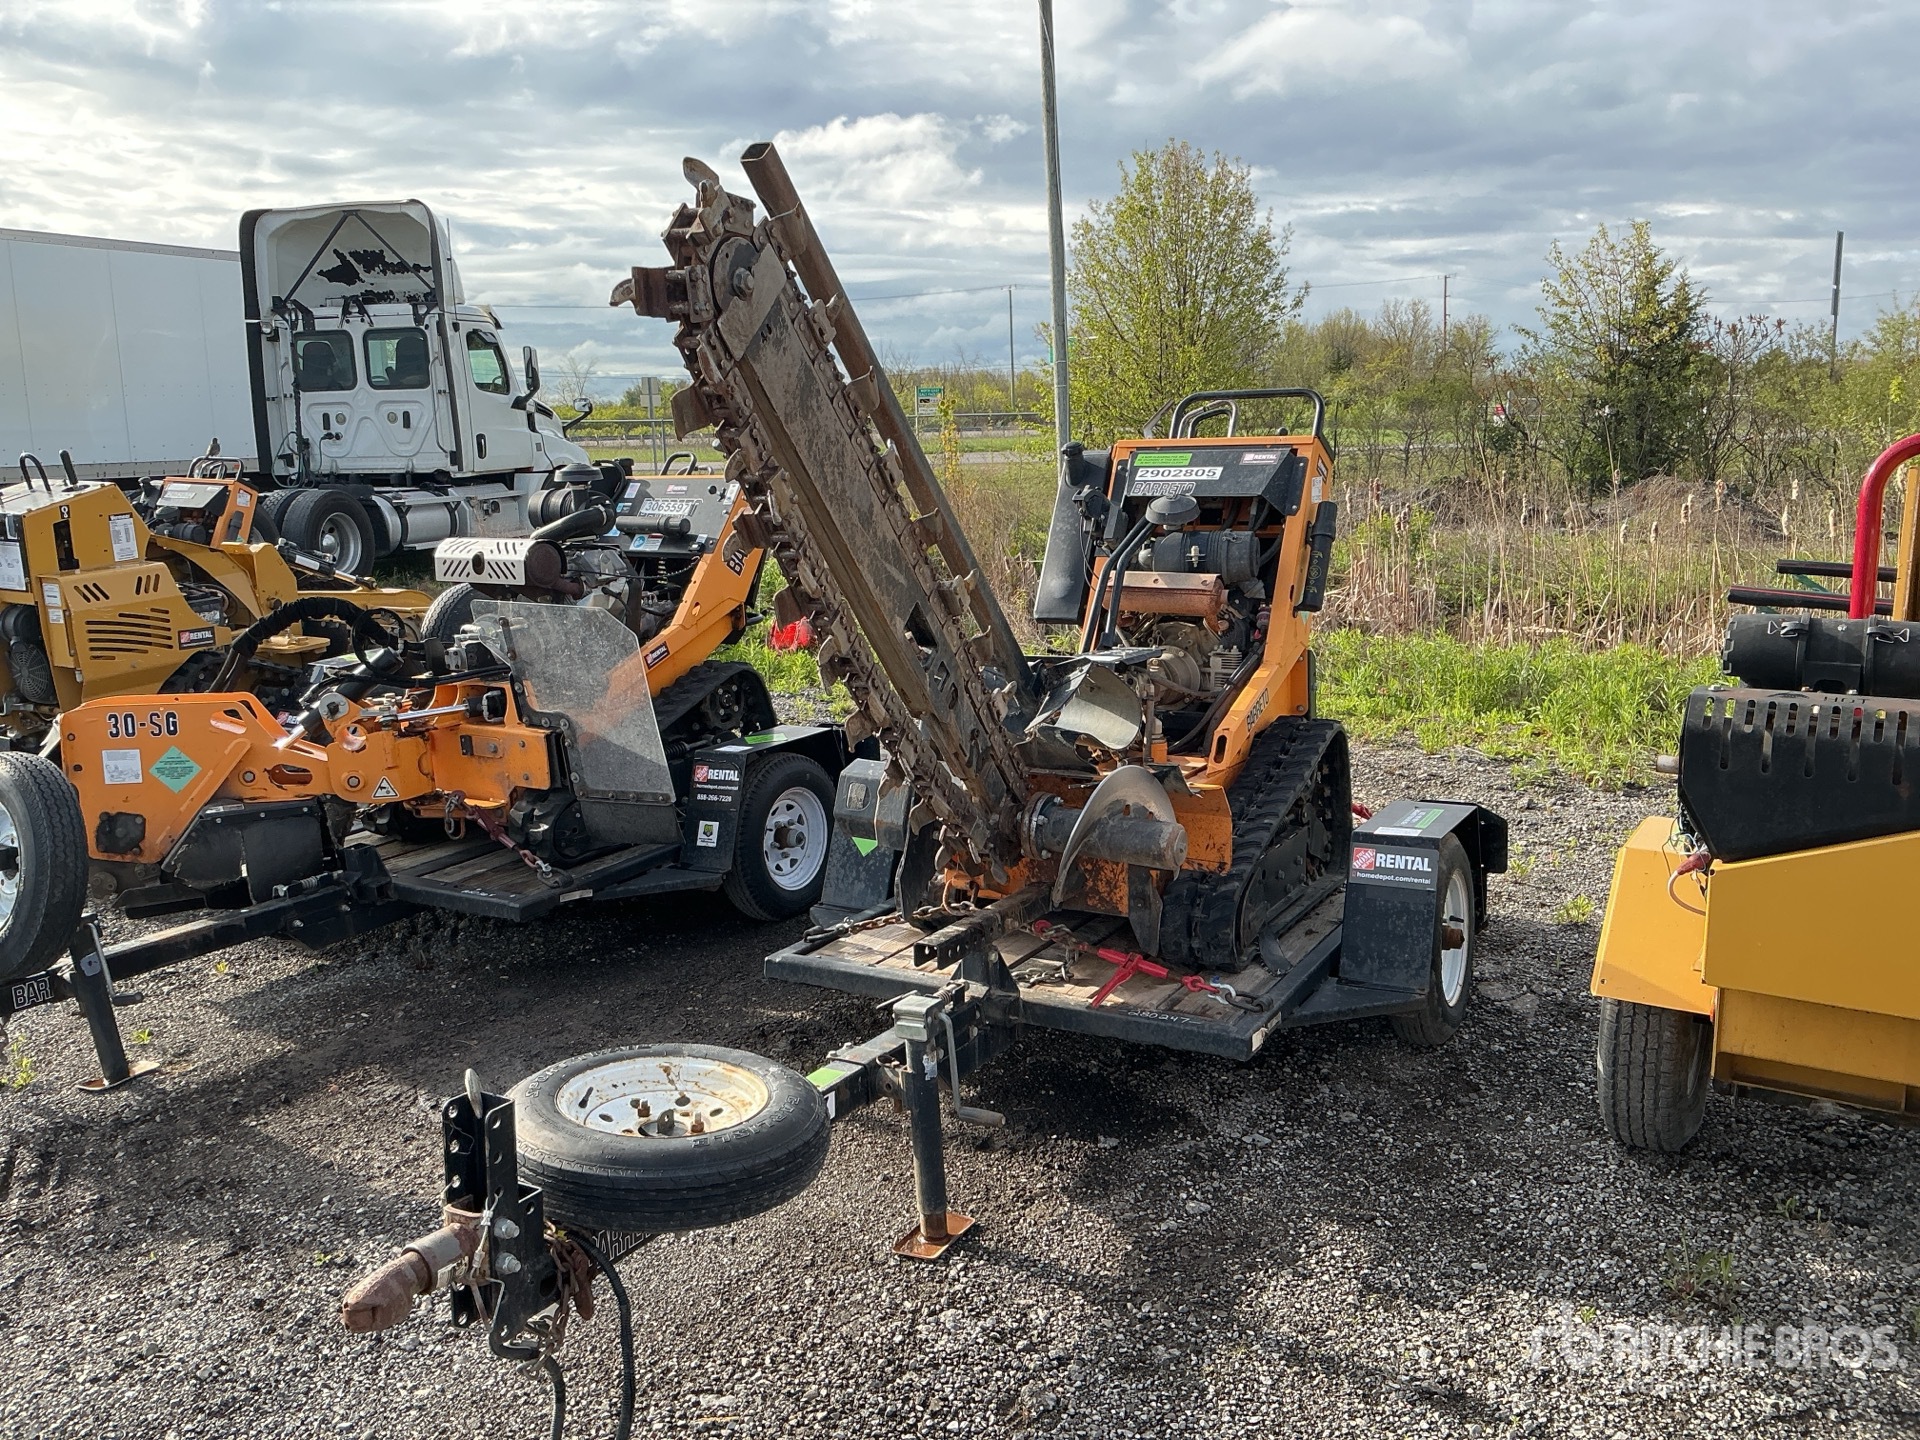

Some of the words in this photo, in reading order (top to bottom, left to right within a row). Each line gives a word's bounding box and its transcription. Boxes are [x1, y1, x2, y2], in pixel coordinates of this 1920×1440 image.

[1138, 468, 1216, 478] 2902805
[1131, 482, 1196, 496] BARRETO
[645, 501, 690, 513] 3065597
[190, 630, 213, 640] RENTAL
[651, 645, 667, 659] RENTAL
[1247, 688, 1269, 732] BARRETO
[107, 710, 179, 738] 30-SG
[708, 769, 739, 781] RENTAL
[1376, 853, 1432, 872] RENTAL
[1356, 871, 1431, 885] homedepot.com/rental
